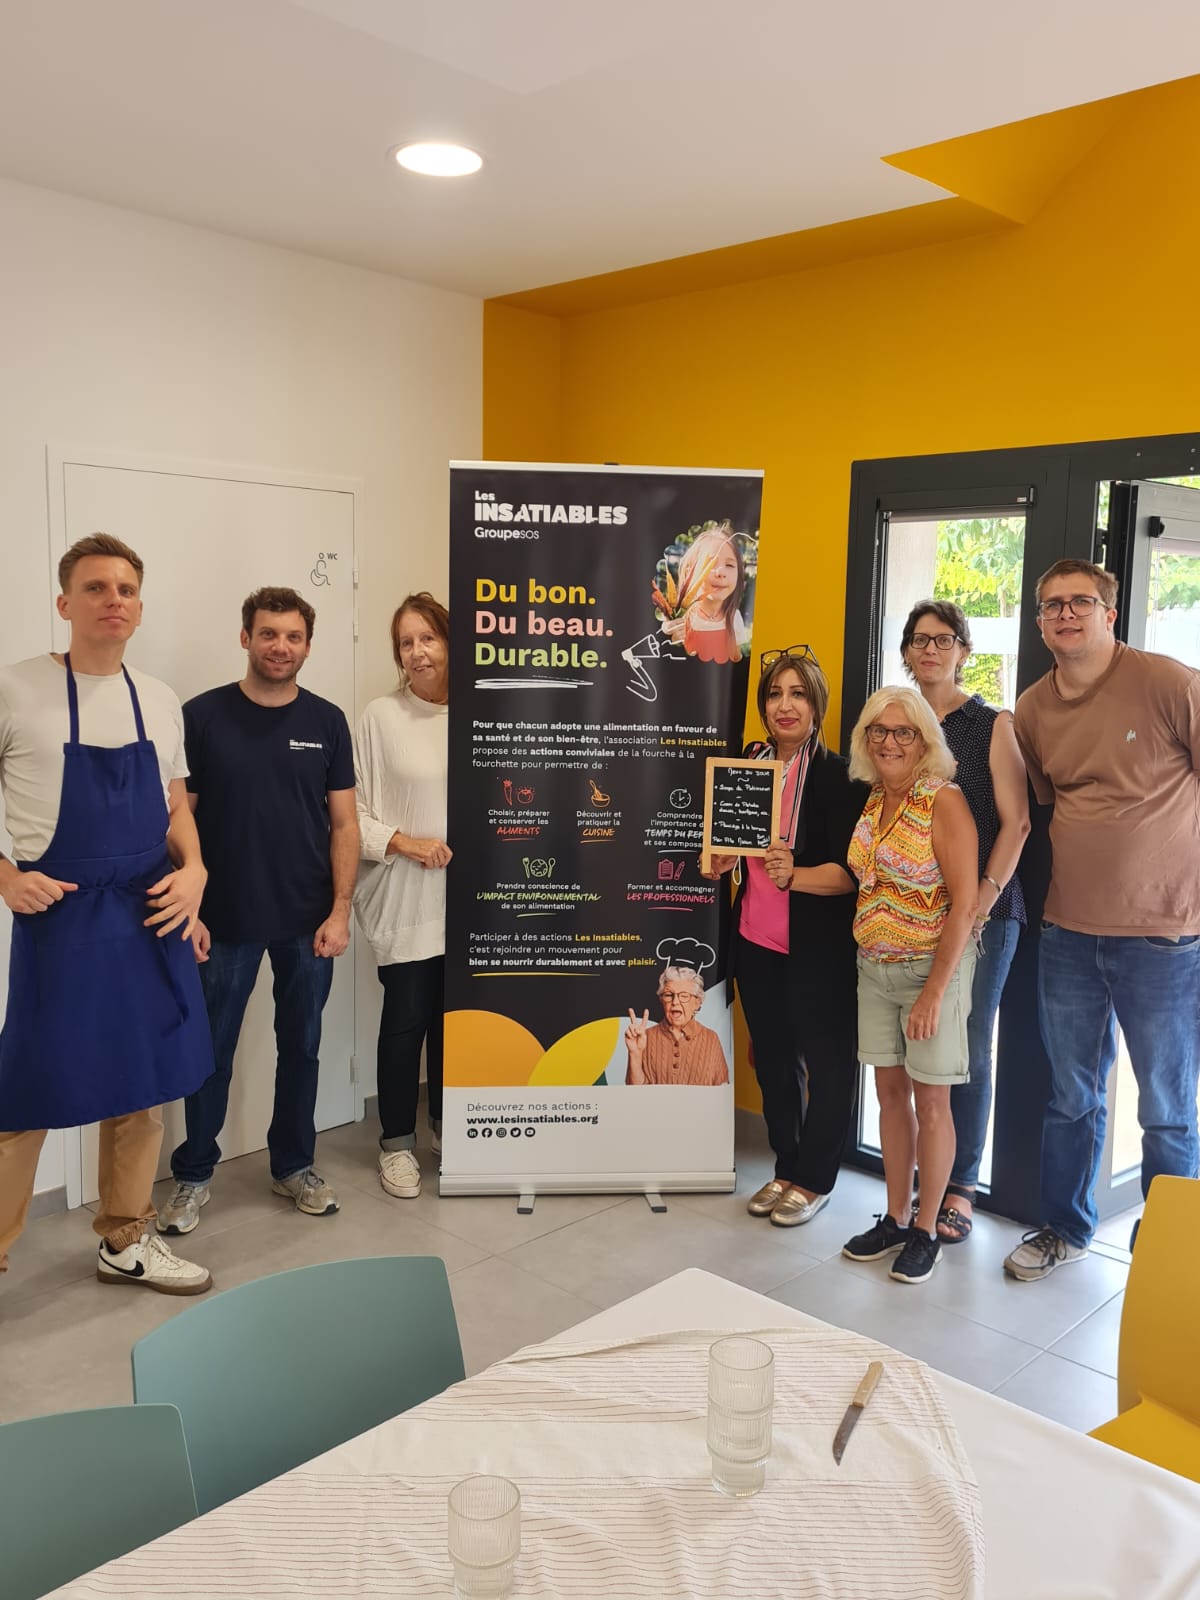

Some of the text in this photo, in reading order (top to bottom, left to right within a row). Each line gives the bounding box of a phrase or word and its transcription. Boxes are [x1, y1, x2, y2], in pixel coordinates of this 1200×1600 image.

[475, 490, 495, 501] Les
[475, 503, 628, 525] INSATIABLES
[327, 552, 338, 560] WC
[476, 578, 596, 605] Du bon.
[475, 610, 614, 637] Du beau.
[475, 642, 608, 668] Durable.
[516, 721, 548, 729] chacun
[550, 722, 581, 732] adopte
[603, 723, 659, 732] alimentation
[675, 725, 704, 733] faveur
[706, 726, 717, 734] de
[485, 734, 510, 742] santé
[525, 734, 535, 742] de
[556, 735, 601, 744] bien-être,
[604, 736, 657, 744] l'association
[660, 737, 676, 745] Les
[678, 738, 727, 747] Insatiables
[473, 748, 508, 756] propose
[566, 749, 615, 757] conviviales
[618, 749, 628, 757] de
[632, 749, 639, 757] la
[642, 749, 676, 757] fourche
[679, 750, 684, 758] à
[687, 750, 695, 759] la
[472, 759, 519, 767] fourchette
[545, 762, 588, 770] permettre
[592, 761, 602, 769] de
[488, 809, 550, 818] Choisir, préparer
[576, 810, 612, 818] Découvrir
[496, 826, 541, 835] ALIMENTS
[582, 828, 615, 836] CUISINE
[644, 829, 704, 838] TEMPS DU REP
[666, 884, 715, 893] accompagner
[477, 892, 601, 902] L'IMPACT ENVIRONNEMENTAL
[627, 893, 715, 903] LES PROFESSIONNELS
[470, 933, 511, 942] Participer
[514, 932, 519, 941] à
[522, 933, 537, 941] des
[540, 933, 572, 941] actions
[593, 933, 642, 942] Insatiables,
[493, 945, 531, 955] rejoindre
[603, 947, 623, 955] pour
[469, 958, 488, 966] bien
[503, 958, 533, 966] nourrir
[536, 958, 592, 966] durablement
[628, 958, 657, 967] plaisir.
[467, 1103, 524, 1112] Découvrez
[528, 1103, 547, 1111] nos
[552, 1102, 591, 1111] actions
[467, 1114, 598, 1124] www.lesinsatiables.org
